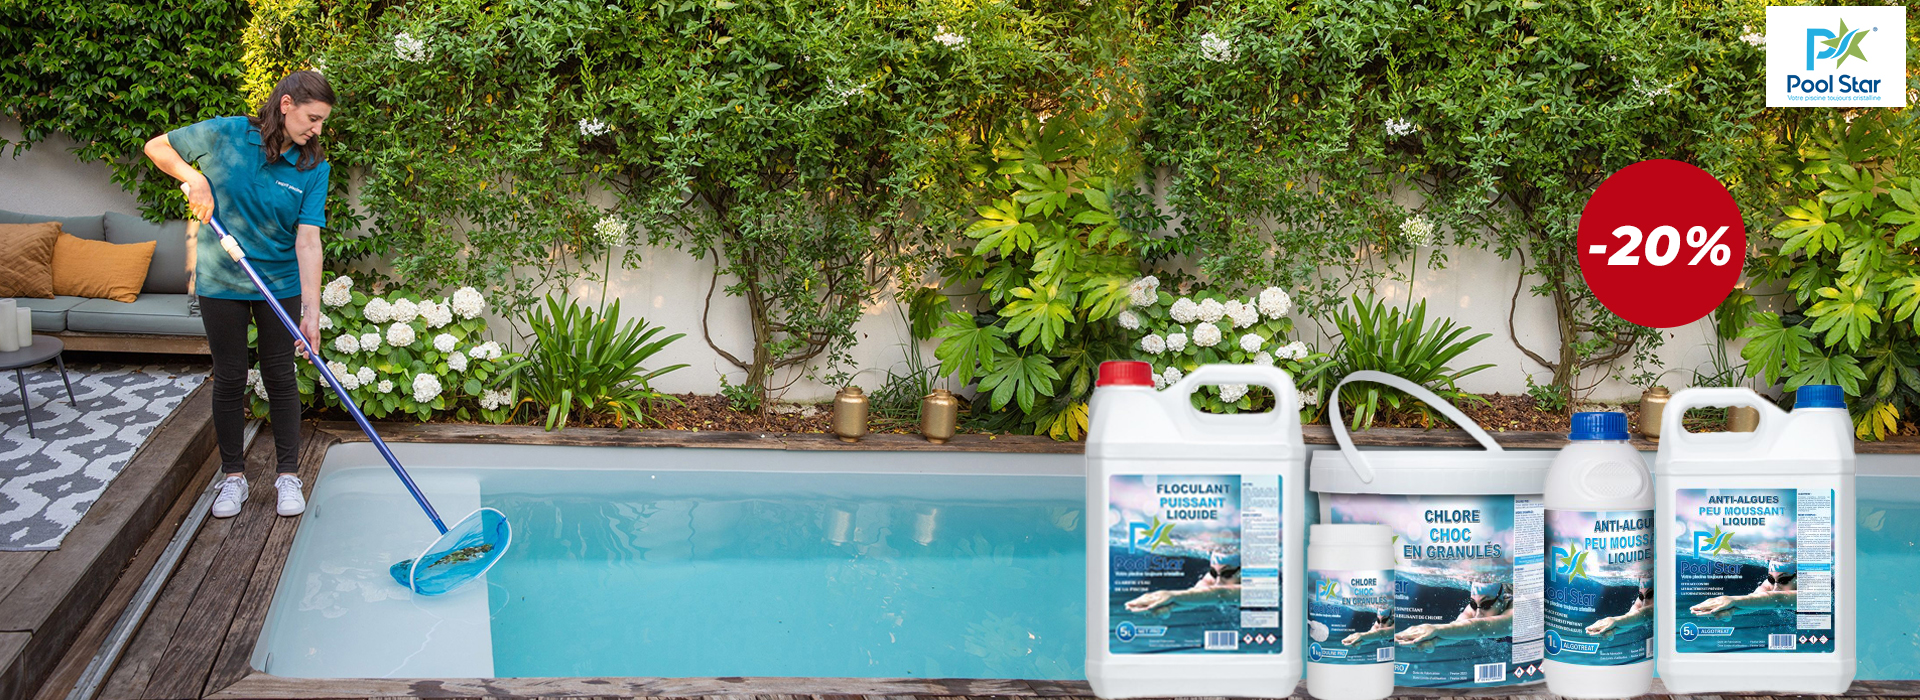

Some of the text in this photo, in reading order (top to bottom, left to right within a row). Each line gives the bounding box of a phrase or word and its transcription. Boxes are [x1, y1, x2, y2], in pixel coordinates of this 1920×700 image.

[1156, 483, 1231, 495] FLOCULANT
[1159, 497, 1226, 508] PUISSANT
[1708, 495, 1779, 504] ANTI-ALGUES
[1166, 509, 1218, 521] LIQUIDE
[1425, 510, 1480, 523] CHLORE
[1699, 506, 1785, 516] PEU MOUSSANT
[1722, 517, 1766, 526] LIQUIDE
[1430, 528, 1472, 543] CHOC
[1584, 537, 1606, 550] PEU
[1403, 541, 1502, 560] EN GRANULÉS
[1608, 548, 1651, 565] LIQUIDE
[1113, 555, 1186, 571] Pool Star
[1680, 561, 1743, 575] Pool Star
[1350, 578, 1377, 586] CHLORE
[1353, 587, 1374, 596] CHOC
[1569, 587, 1596, 607] Star
[1341, 597, 1351, 605] EN
[1683, 626, 1694, 636] 5L
[1547, 634, 1558, 649] 1L
[1563, 641, 1595, 652] ALGOTREAT
[1394, 664, 1405, 672] RO
